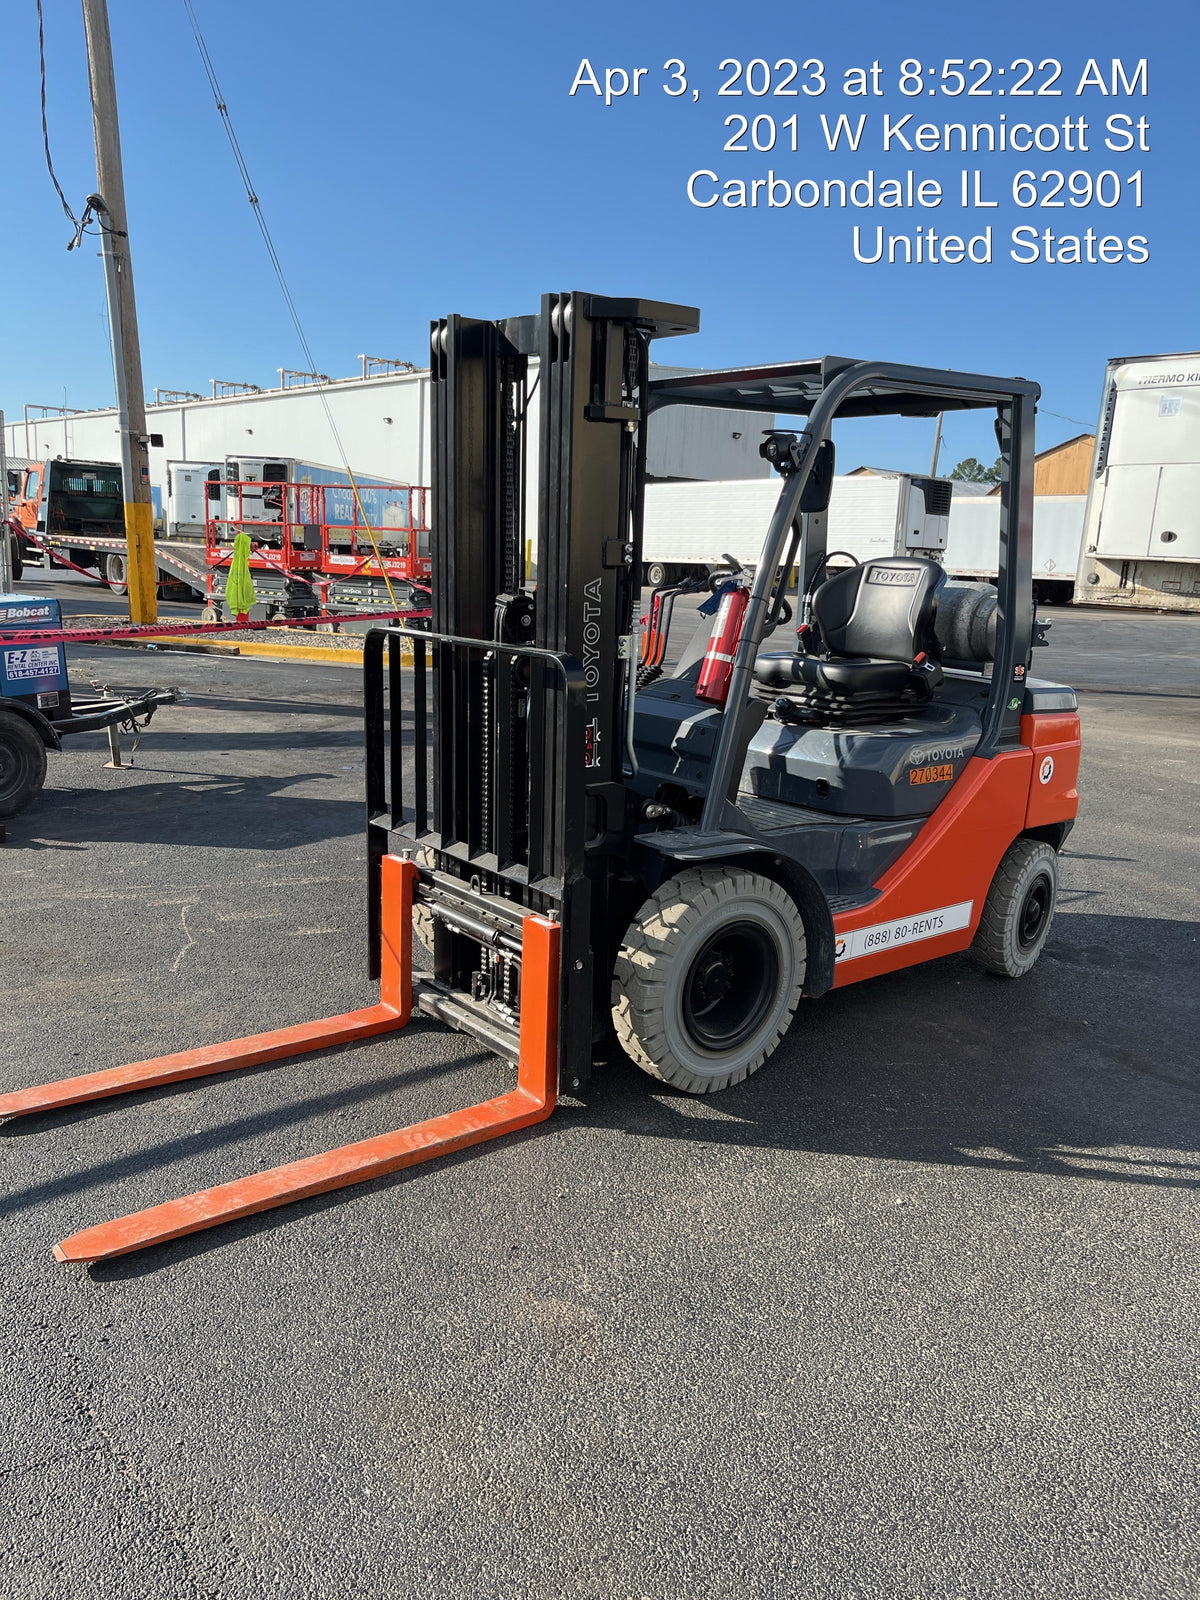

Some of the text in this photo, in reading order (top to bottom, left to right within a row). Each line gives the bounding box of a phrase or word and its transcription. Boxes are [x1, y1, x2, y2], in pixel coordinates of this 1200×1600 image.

[872, 570, 915, 583] TOYOTA
[7, 606, 50, 618] Bobcat
[8, 650, 28, 664] E-Z
[8, 667, 58, 678] 618-457-4127
[926, 746, 965, 762] TOYOTA
[910, 765, 953, 785] 270344
[863, 915, 945, 949] (888) 80-RENTS
